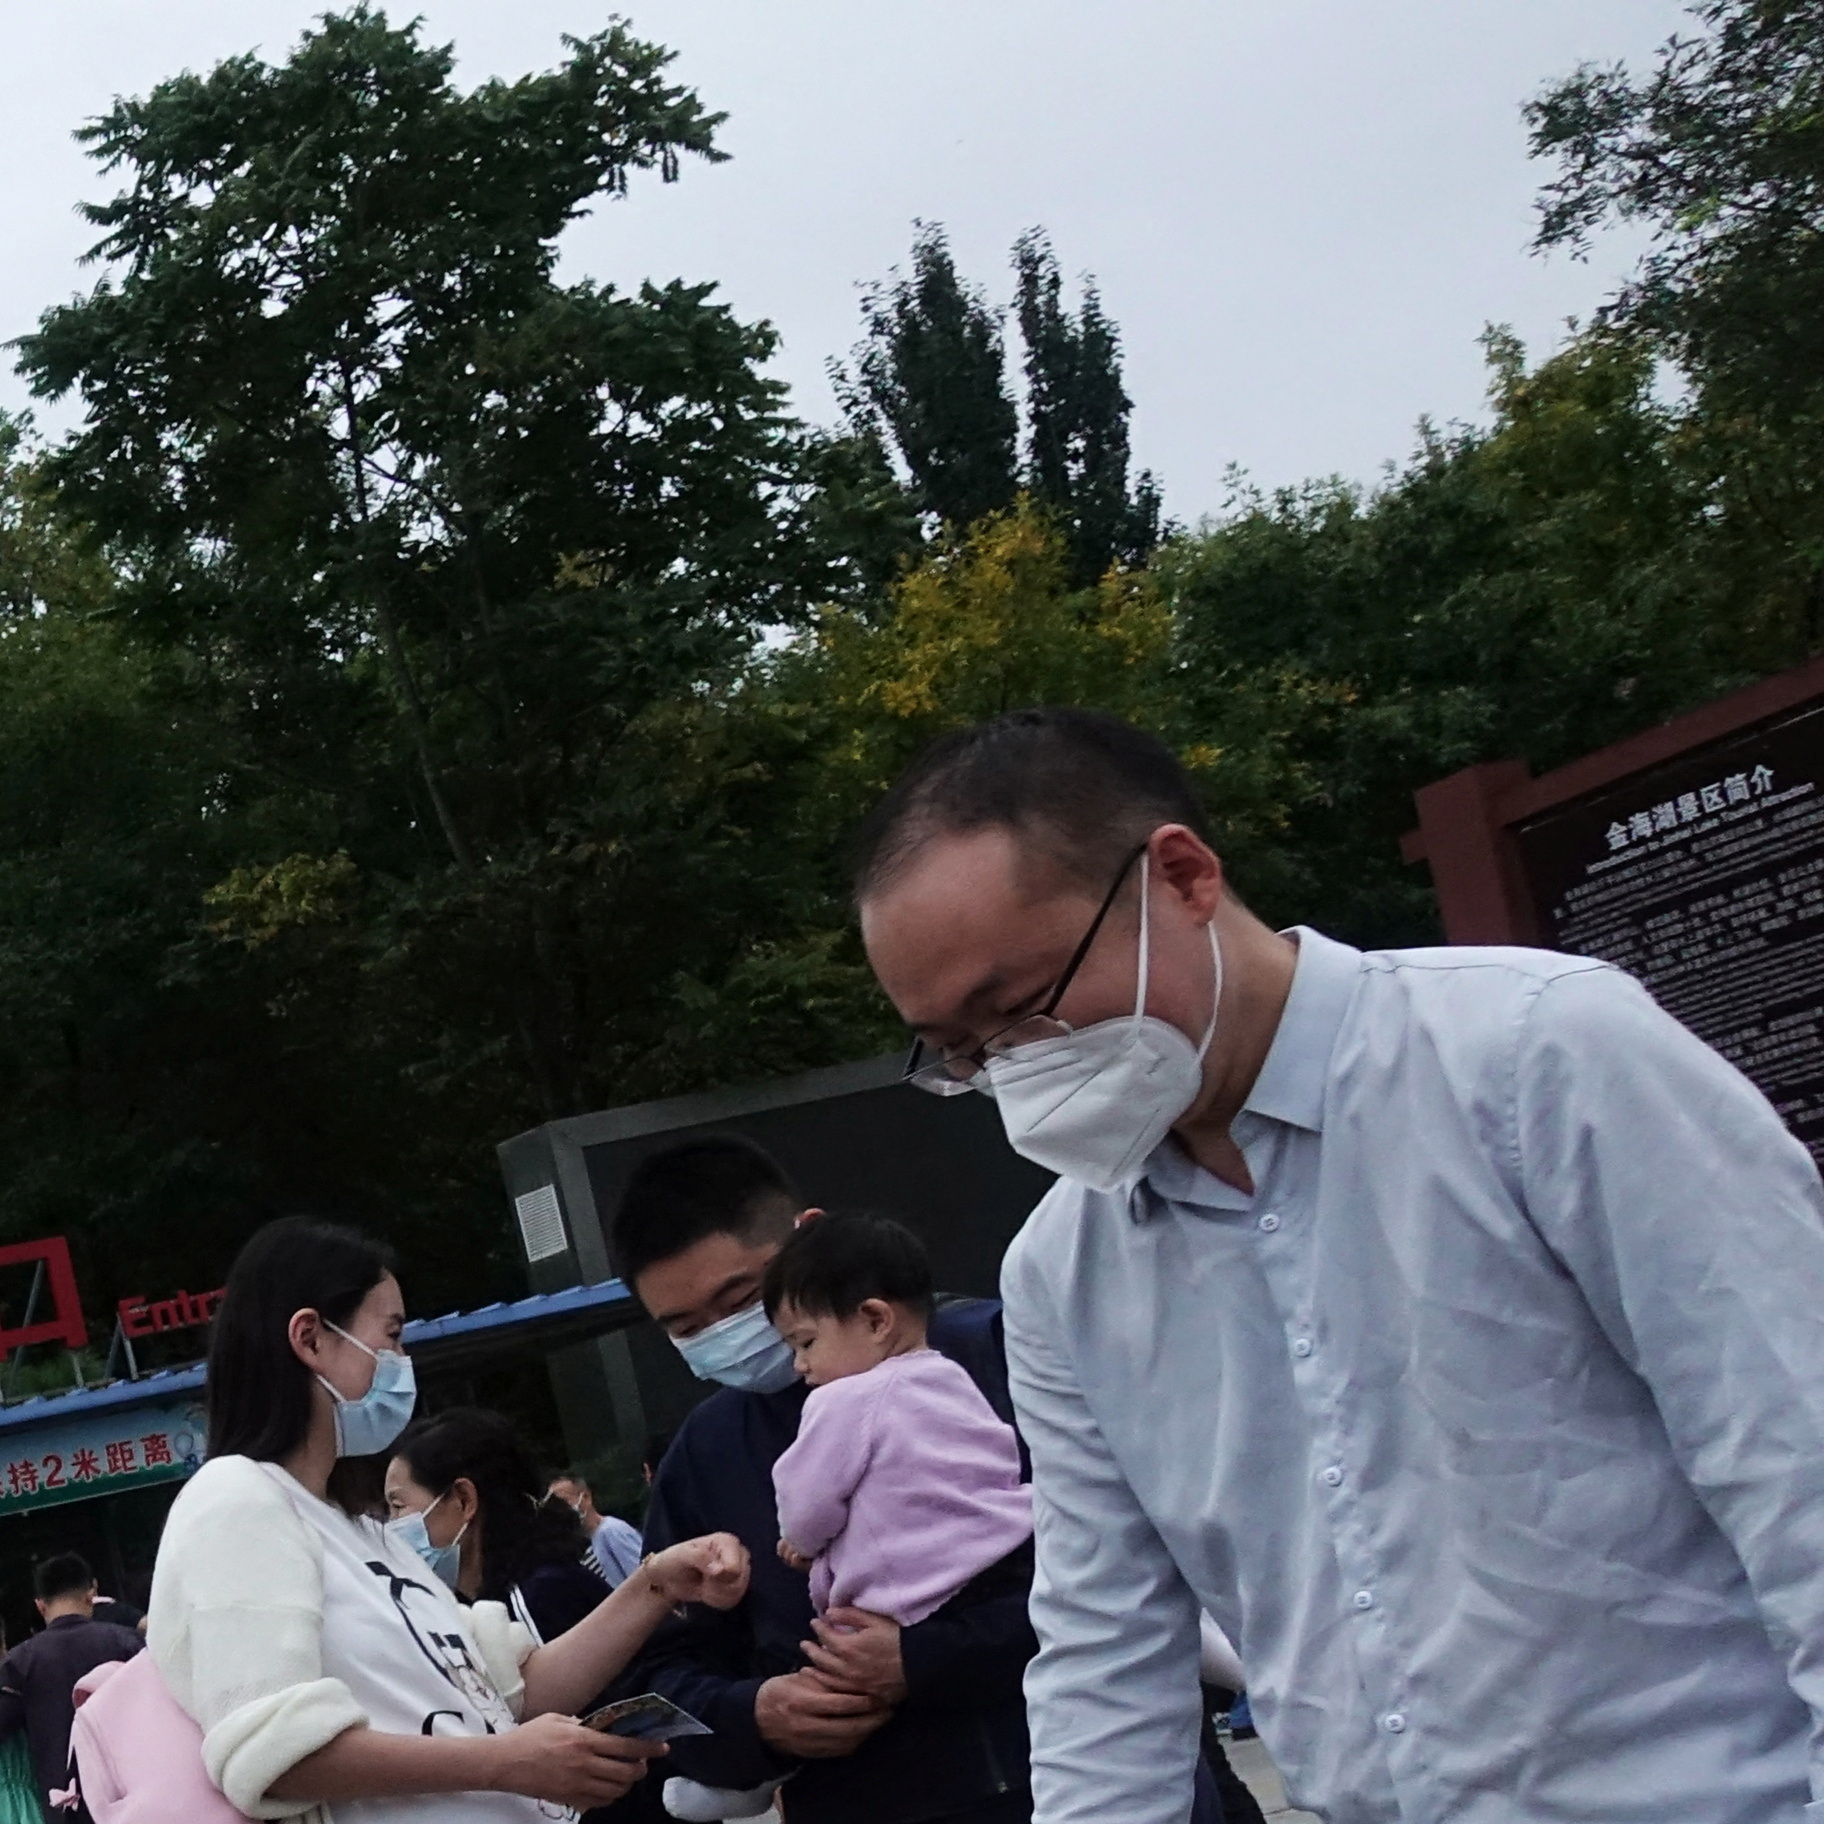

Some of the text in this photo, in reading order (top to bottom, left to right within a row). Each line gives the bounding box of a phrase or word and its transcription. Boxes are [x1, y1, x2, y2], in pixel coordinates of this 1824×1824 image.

[1604, 763, 1775, 851] 金海湖景区简介
[117, 1285, 231, 1339] Entr
